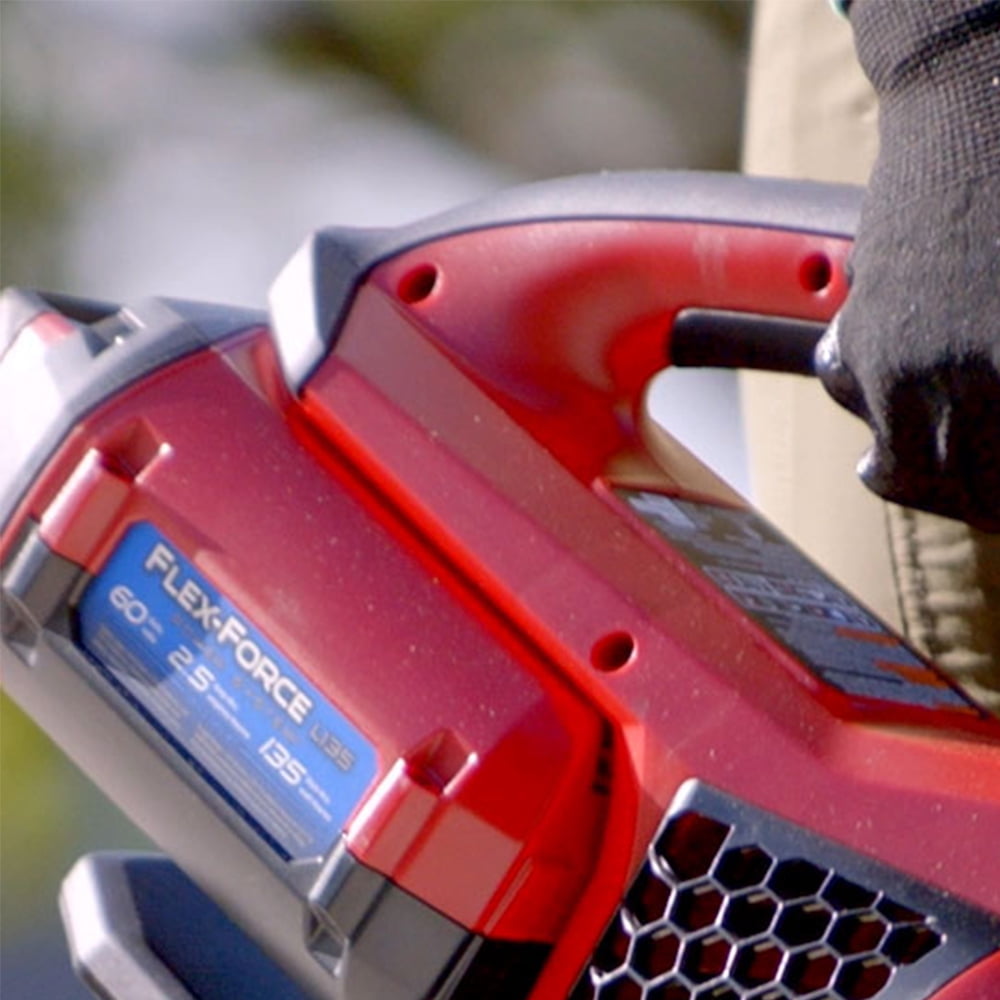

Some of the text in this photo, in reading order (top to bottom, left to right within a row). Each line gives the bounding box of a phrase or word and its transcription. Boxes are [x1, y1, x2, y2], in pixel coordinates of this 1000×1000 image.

[108, 584, 150, 626] 60
[167, 644, 217, 693] 2.5
[257, 737, 307, 787] 135
